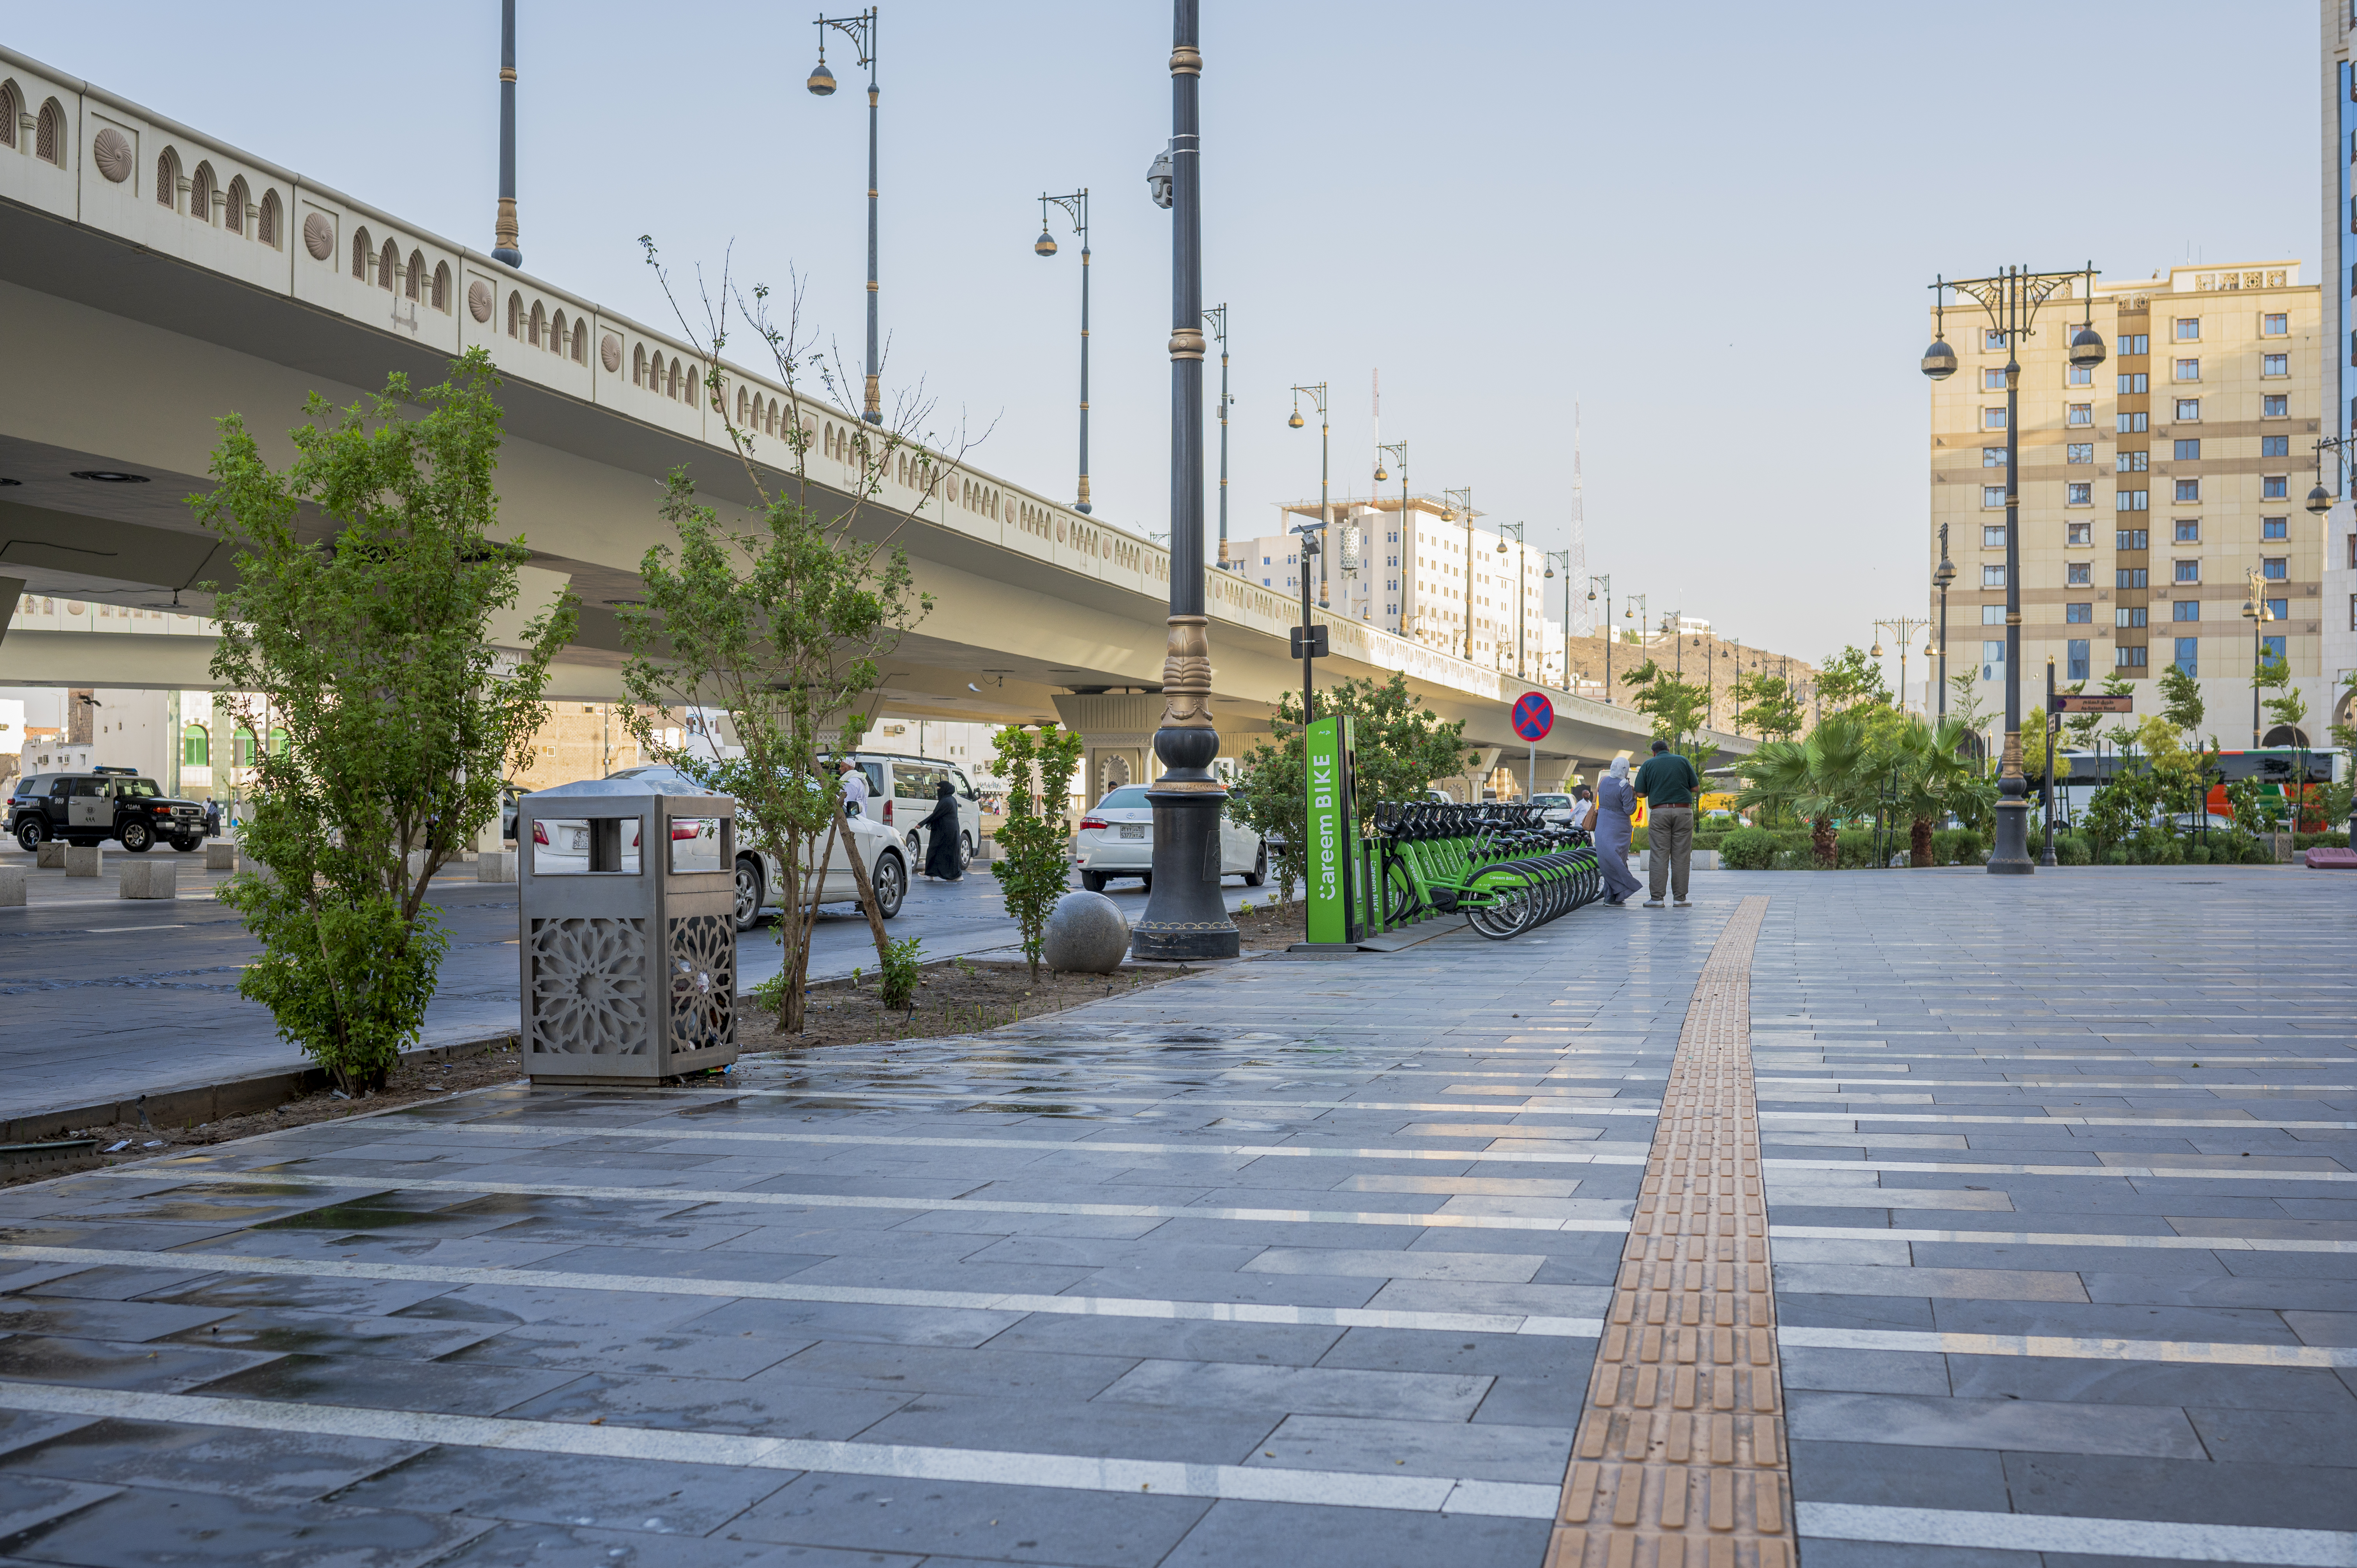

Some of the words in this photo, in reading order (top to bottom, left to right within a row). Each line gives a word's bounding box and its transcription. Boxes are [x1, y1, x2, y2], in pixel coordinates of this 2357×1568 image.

[1313, 755, 1331, 808] BIKE
[1319, 815, 1335, 900] Careem
[1423, 857, 1434, 878] Careem
[1435, 853, 1446, 874] Careem
[1447, 852, 1457, 872] Careem
[1408, 860, 1419, 883] Careem
